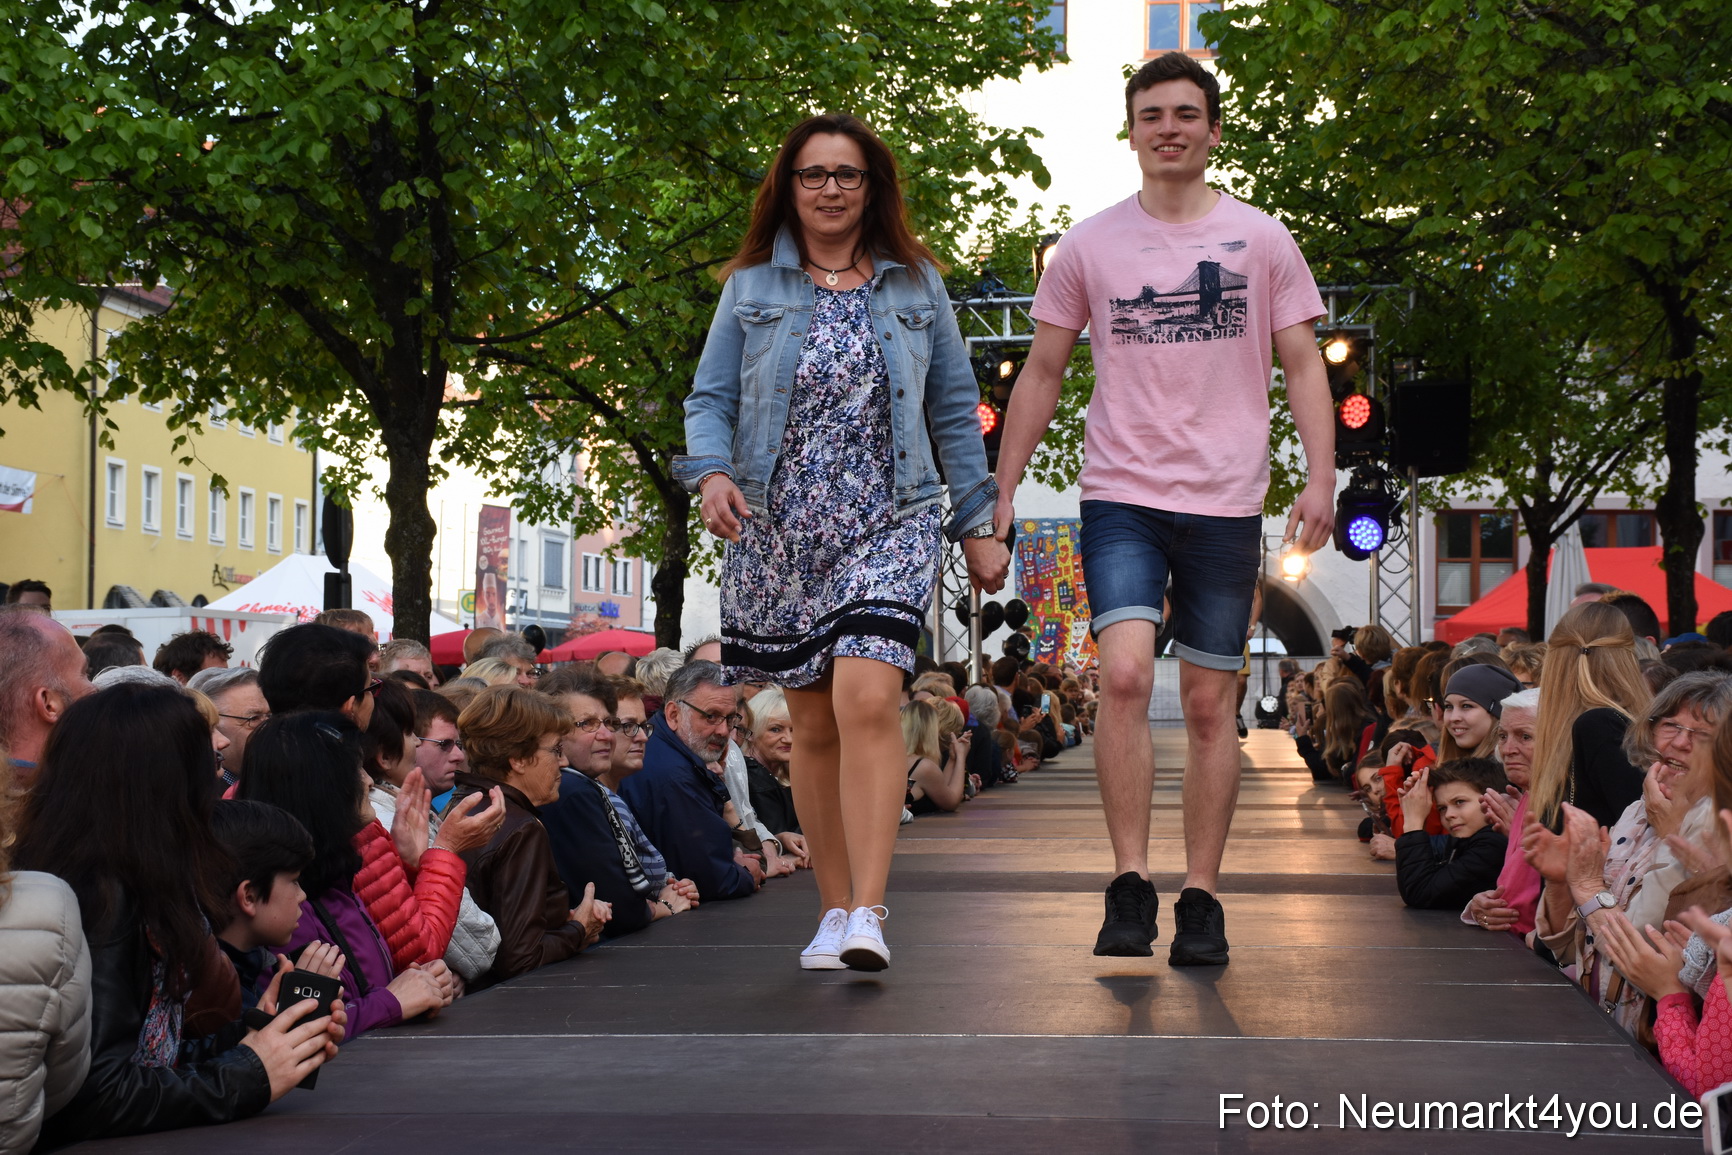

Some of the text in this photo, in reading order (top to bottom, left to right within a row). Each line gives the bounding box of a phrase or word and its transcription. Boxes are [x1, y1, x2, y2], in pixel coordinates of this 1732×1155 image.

[1216, 307, 1246, 327] US
[1112, 327, 1247, 344] BROOKLYN PIER
